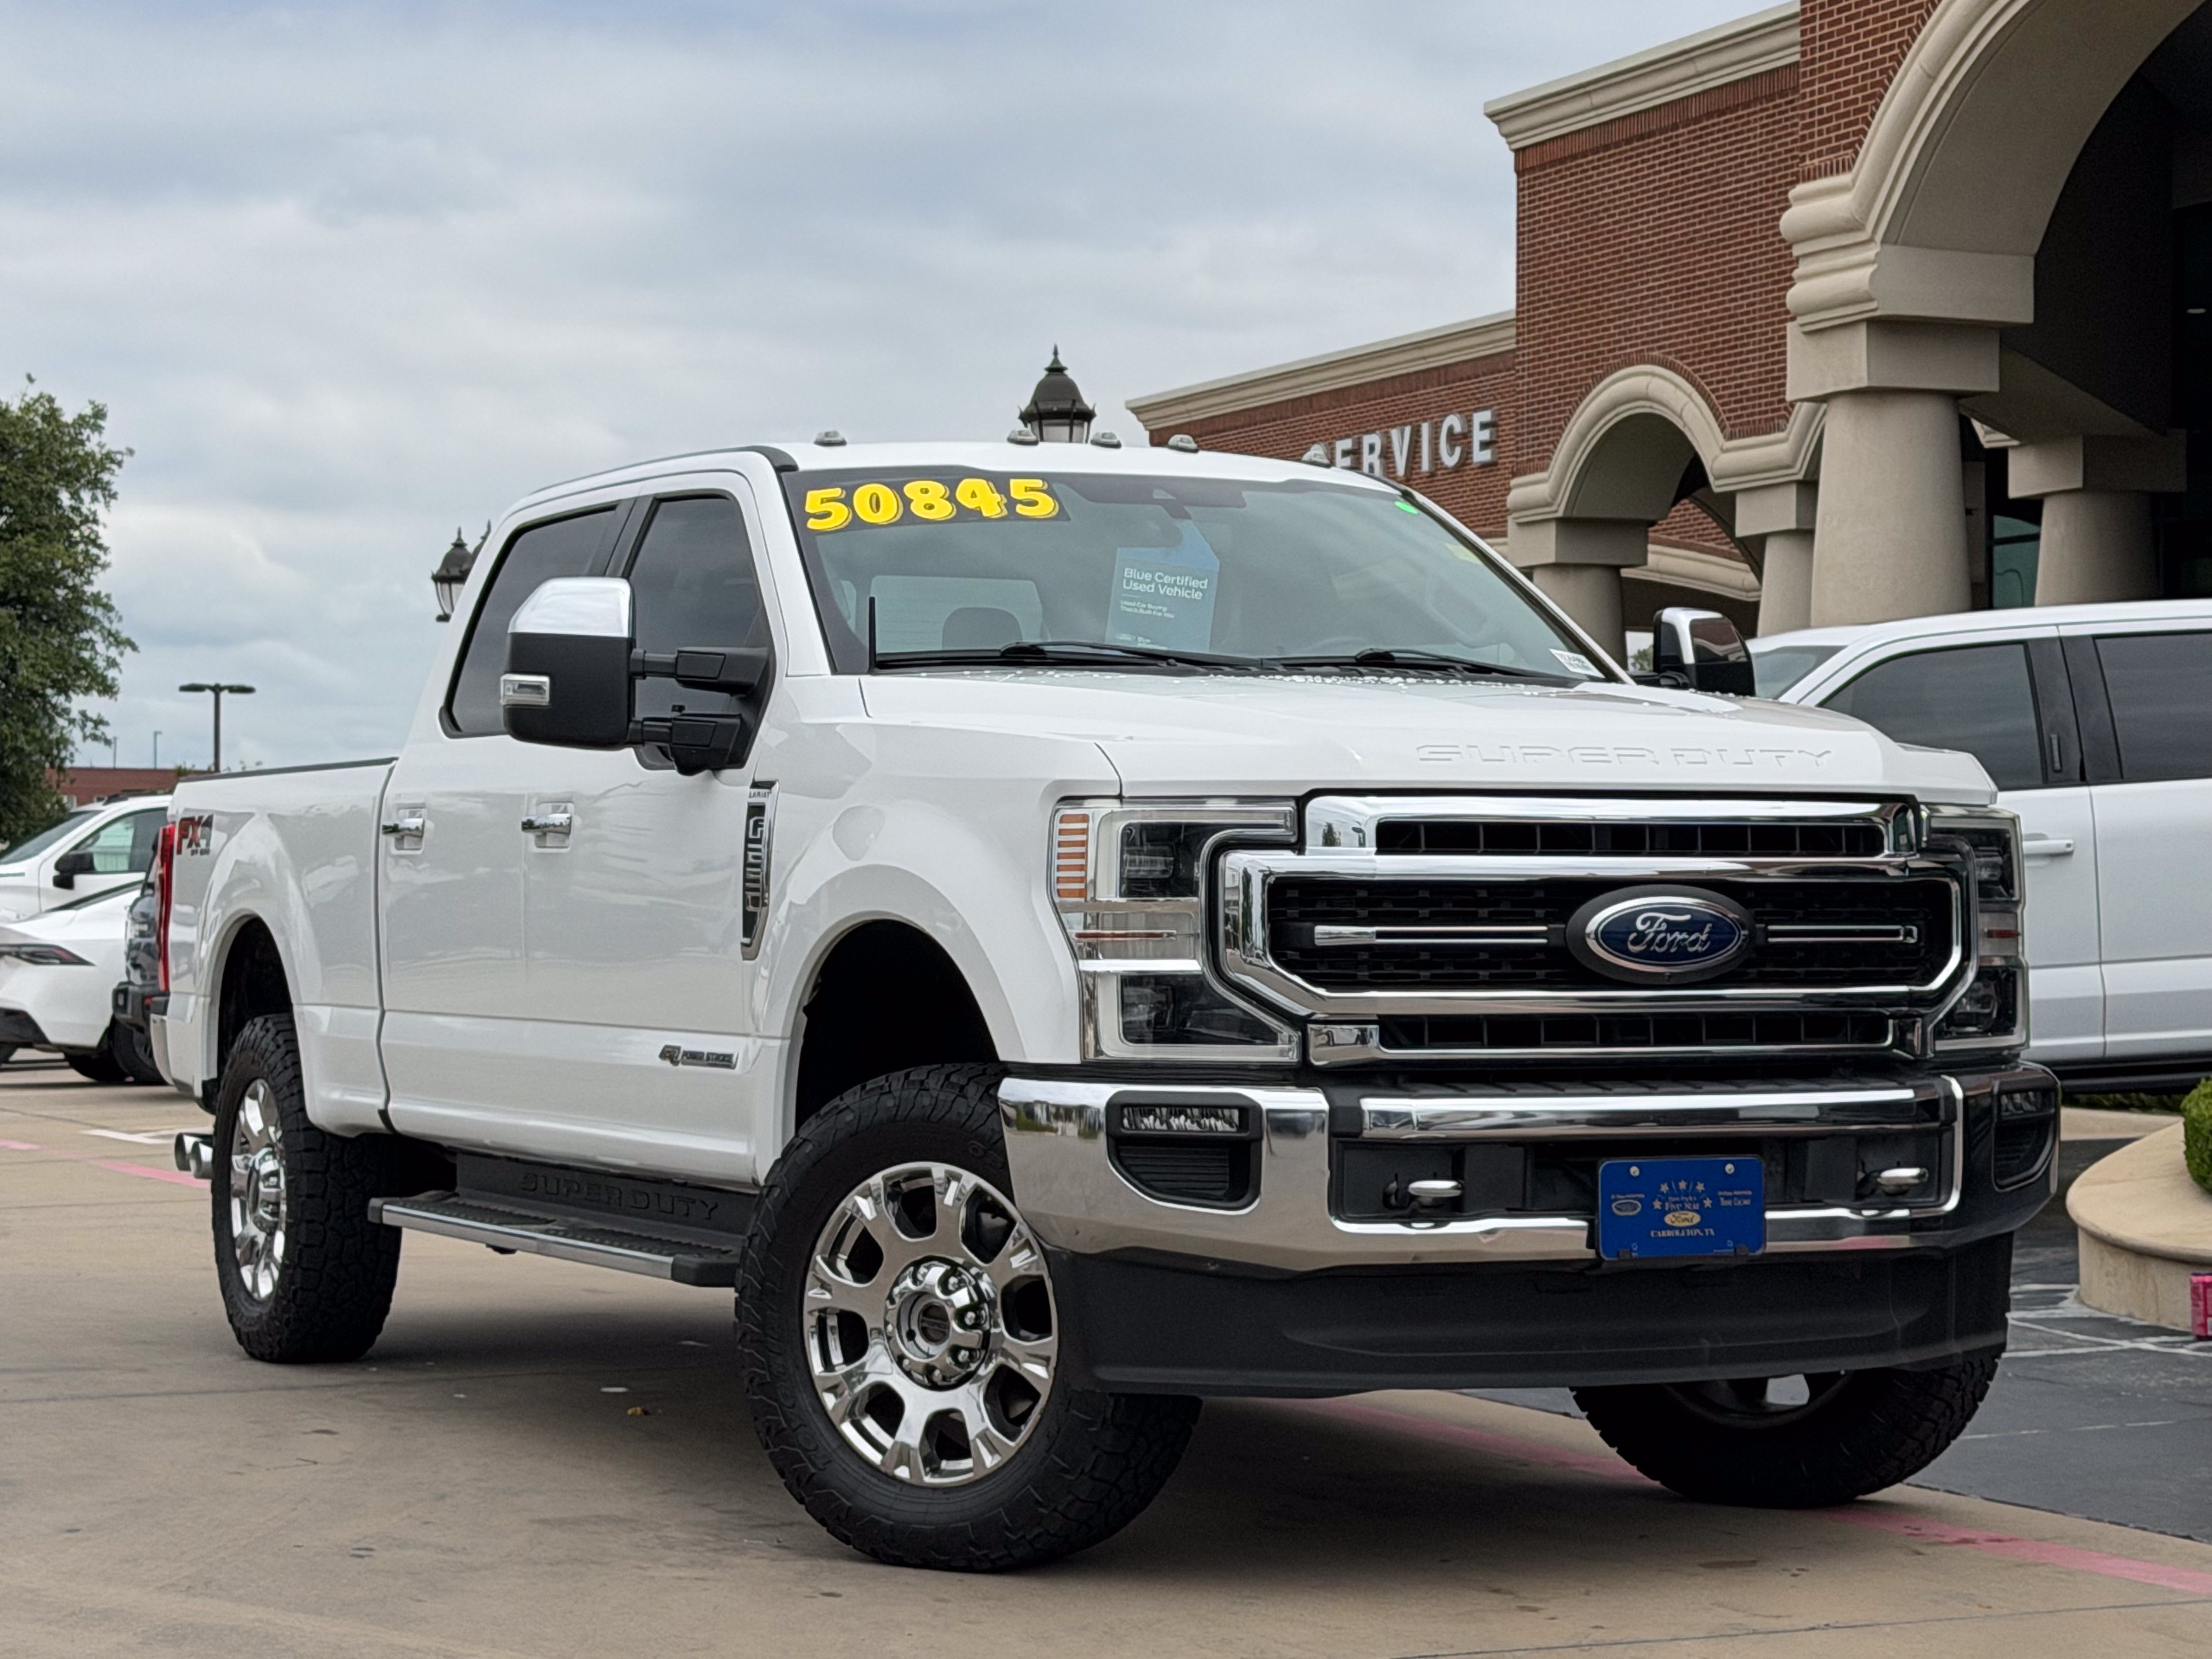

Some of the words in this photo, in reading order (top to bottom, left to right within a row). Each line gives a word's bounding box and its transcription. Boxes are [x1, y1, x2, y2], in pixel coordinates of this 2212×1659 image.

[1308, 409, 1495, 476] ERVICE
[805, 478, 1058, 531] 50845
[1123, 578, 1155, 592] Used
[1158, 584, 1203, 600] Vehicle
[1124, 567, 1152, 580] Blue
[1154, 572, 1208, 589] Certified
[1415, 744, 1660, 765] SUPER
[1670, 748, 1832, 767] DUTY
[176, 814, 213, 855] FX4
[1627, 912, 1713, 953] Ford
[521, 1172, 623, 1207] SUPER
[631, 1189, 719, 1220] DUTY
